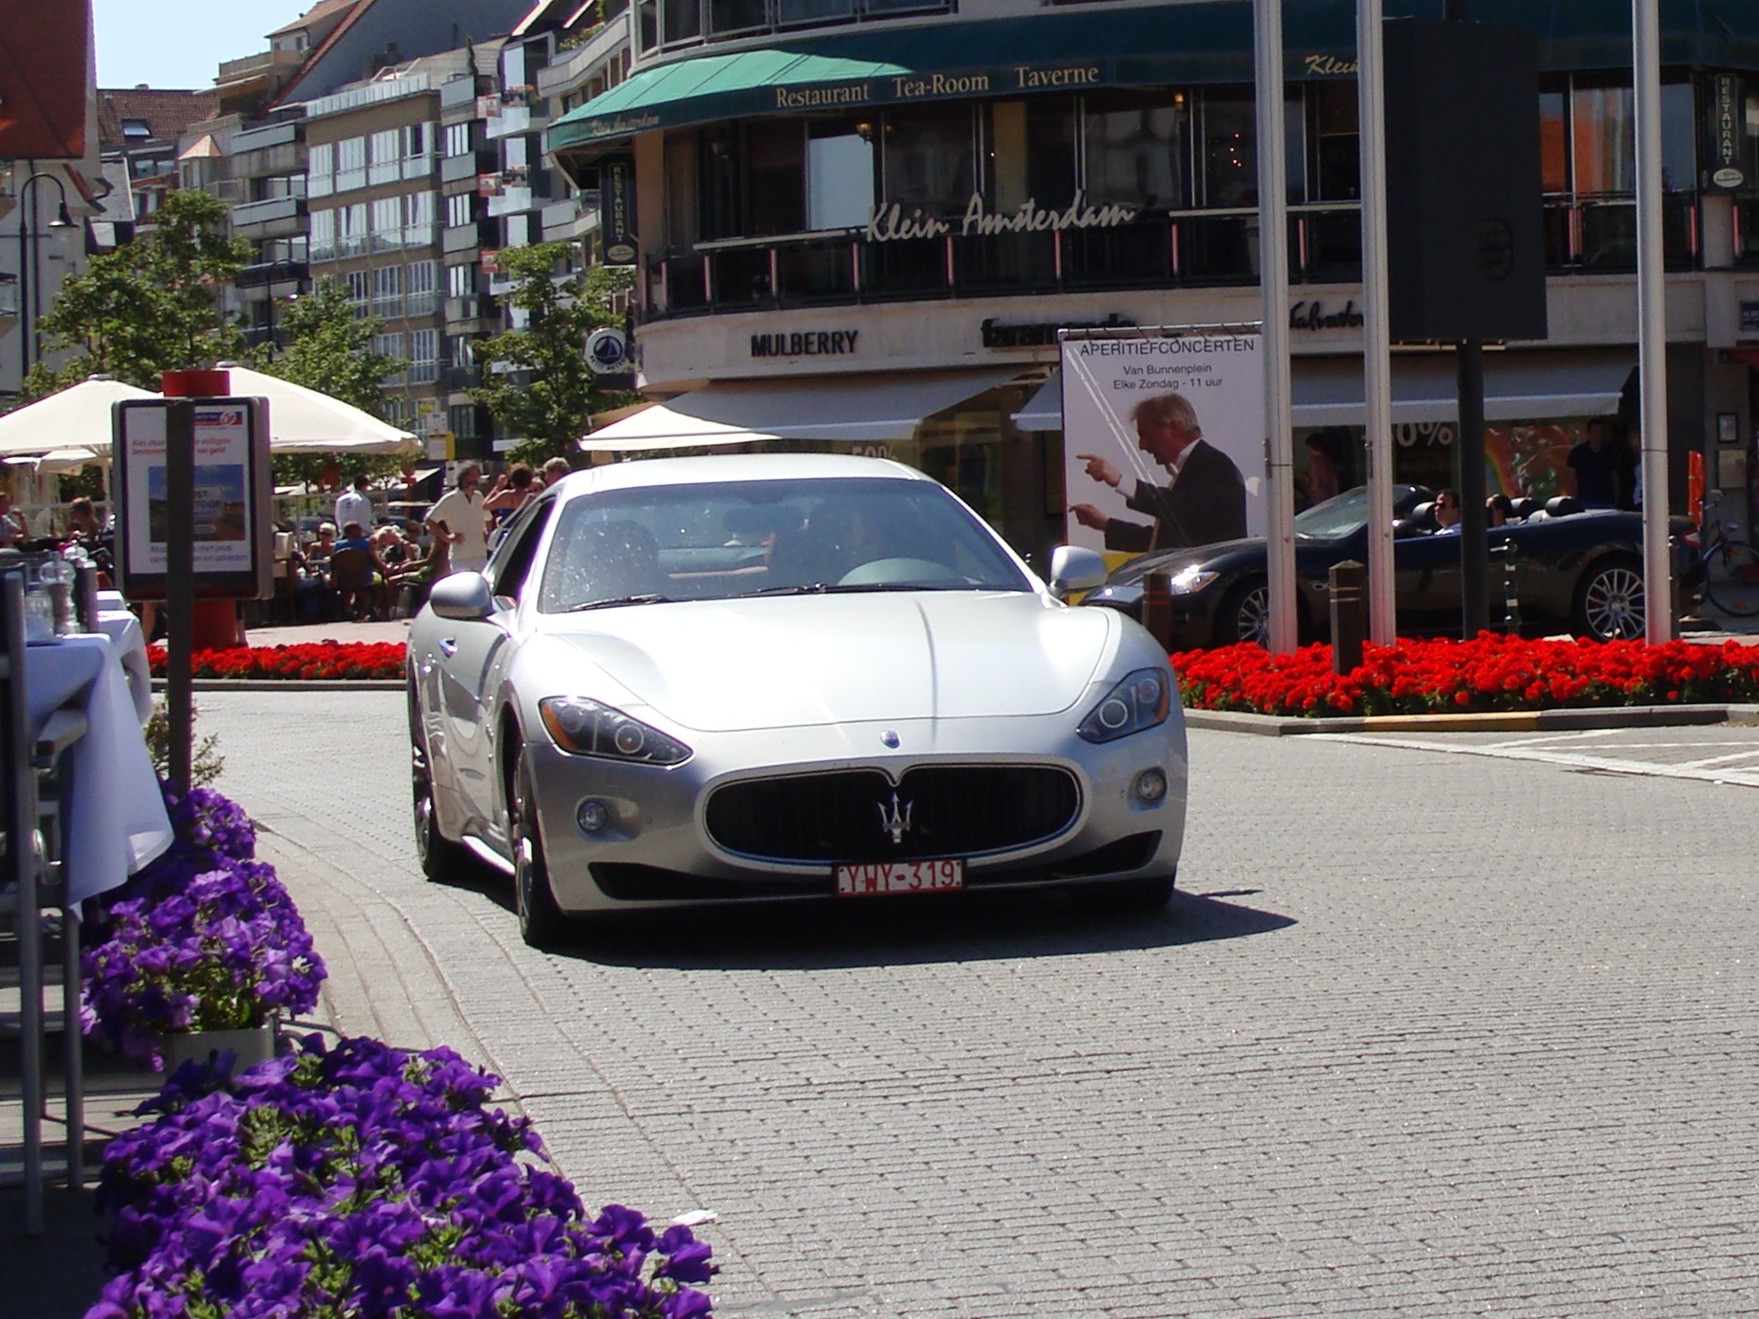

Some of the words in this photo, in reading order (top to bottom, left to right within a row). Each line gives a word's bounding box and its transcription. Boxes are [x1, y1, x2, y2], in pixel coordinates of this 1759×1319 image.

[775, 83, 870, 108] Restaurant
[892, 73, 990, 98] Tea-Room
[1014, 66, 1100, 88] Taverne
[1720, 77, 1733, 165] RESTAURANT
[867, 200, 950, 243] Klein
[962, 188, 1137, 238] Amsterdam
[1289, 300, 1364, 331] Salvato
[750, 329, 859, 357] MULBERRY
[1080, 338, 1256, 357] APERITIEFCONCERTEN
[1113, 378, 1136, 390] Elke
[1139, 379, 1180, 390] Zondag
[1190, 377, 1202, 387] 11
[1205, 378, 1223, 388] uur
[1123, 365, 1144, 375] Van
[1147, 363, 1213, 377] Bunnenplein
[1396, 421, 1454, 447] 0%
[846, 860, 955, 892] YWY-319
